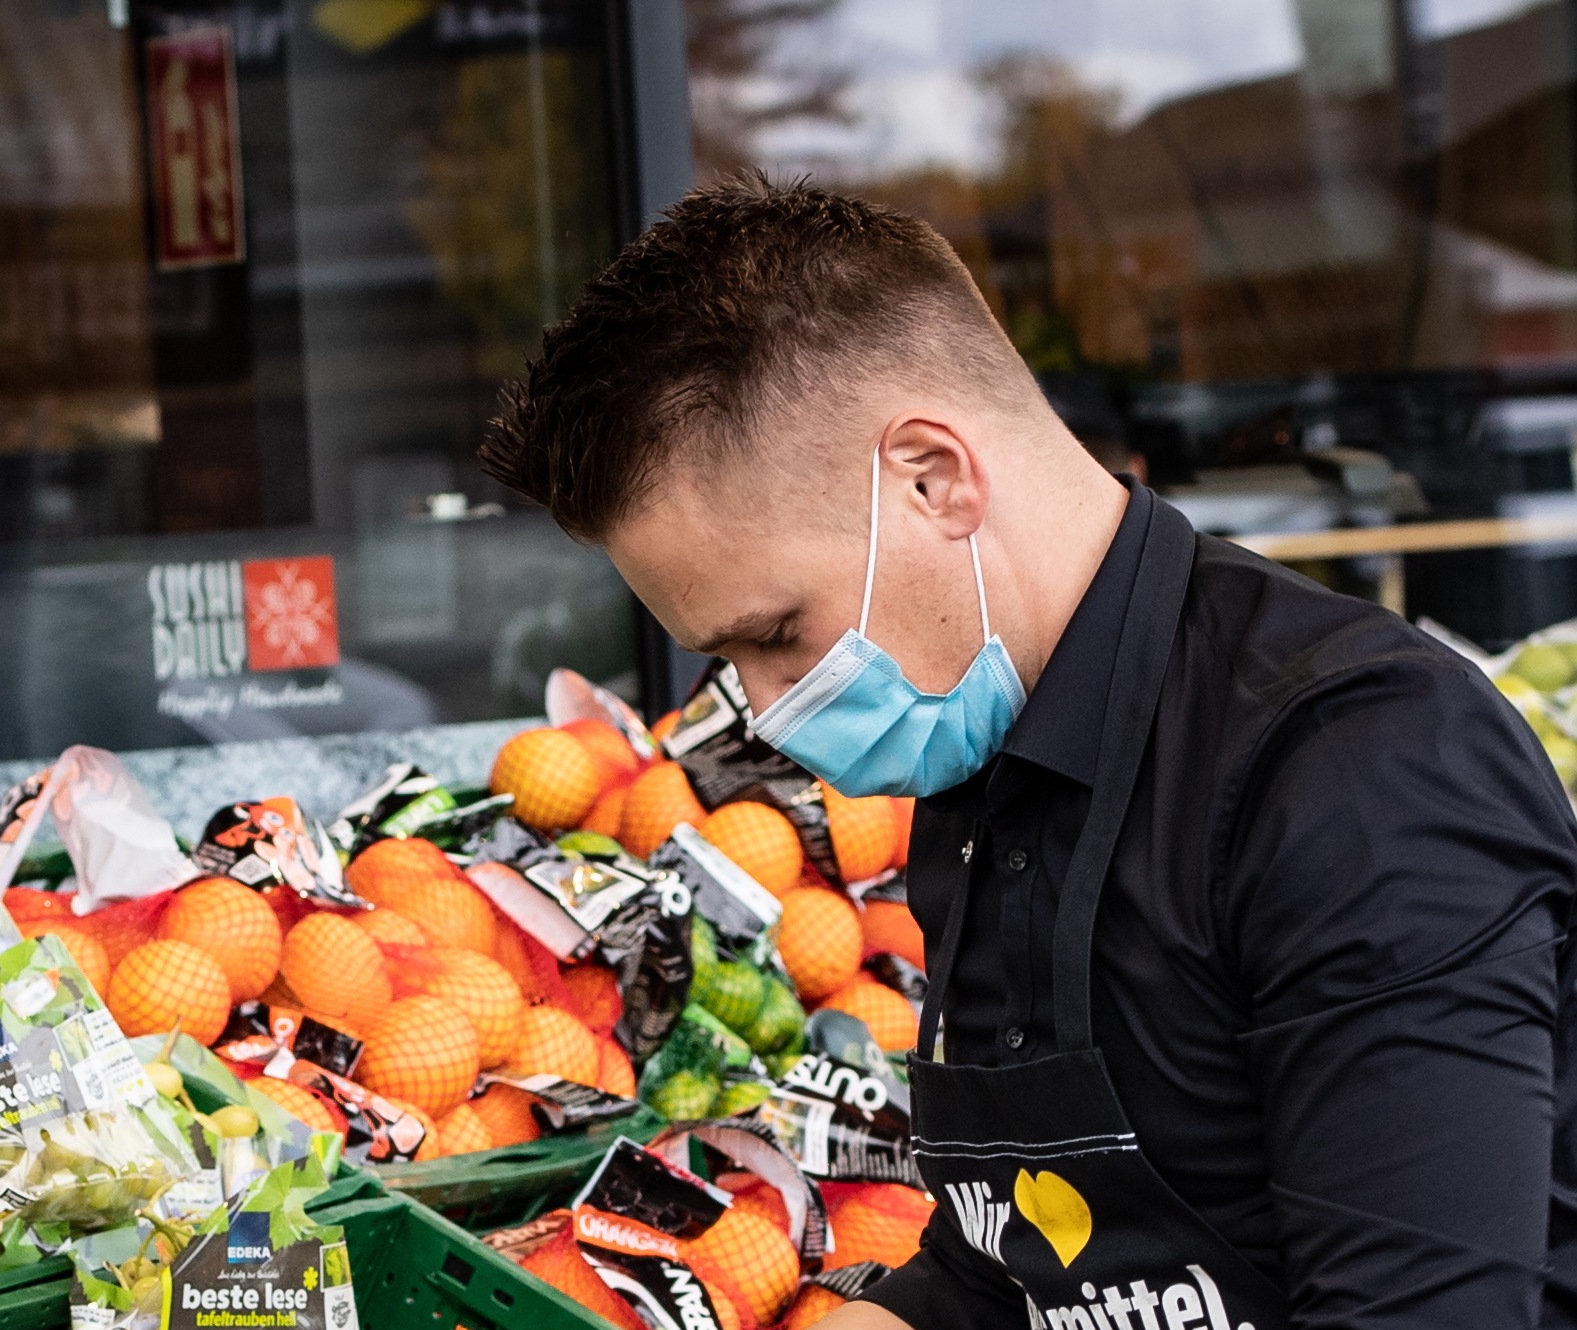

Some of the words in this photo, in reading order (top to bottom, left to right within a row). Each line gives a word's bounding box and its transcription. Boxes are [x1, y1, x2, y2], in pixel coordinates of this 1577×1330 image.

[147, 560, 242, 621] SUSHI
[152, 620, 245, 681] DAILY
[26, 1071, 62, 1098] lese
[784, 1054, 888, 1113] OUTS
[945, 1181, 1011, 1267] Wir
[228, 1246, 272, 1259] EDEKA
[182, 1283, 259, 1310] beste
[265, 1282, 307, 1310] lese
[196, 1311, 274, 1327] tafeltrauben
[277, 1311, 297, 1326] hell
